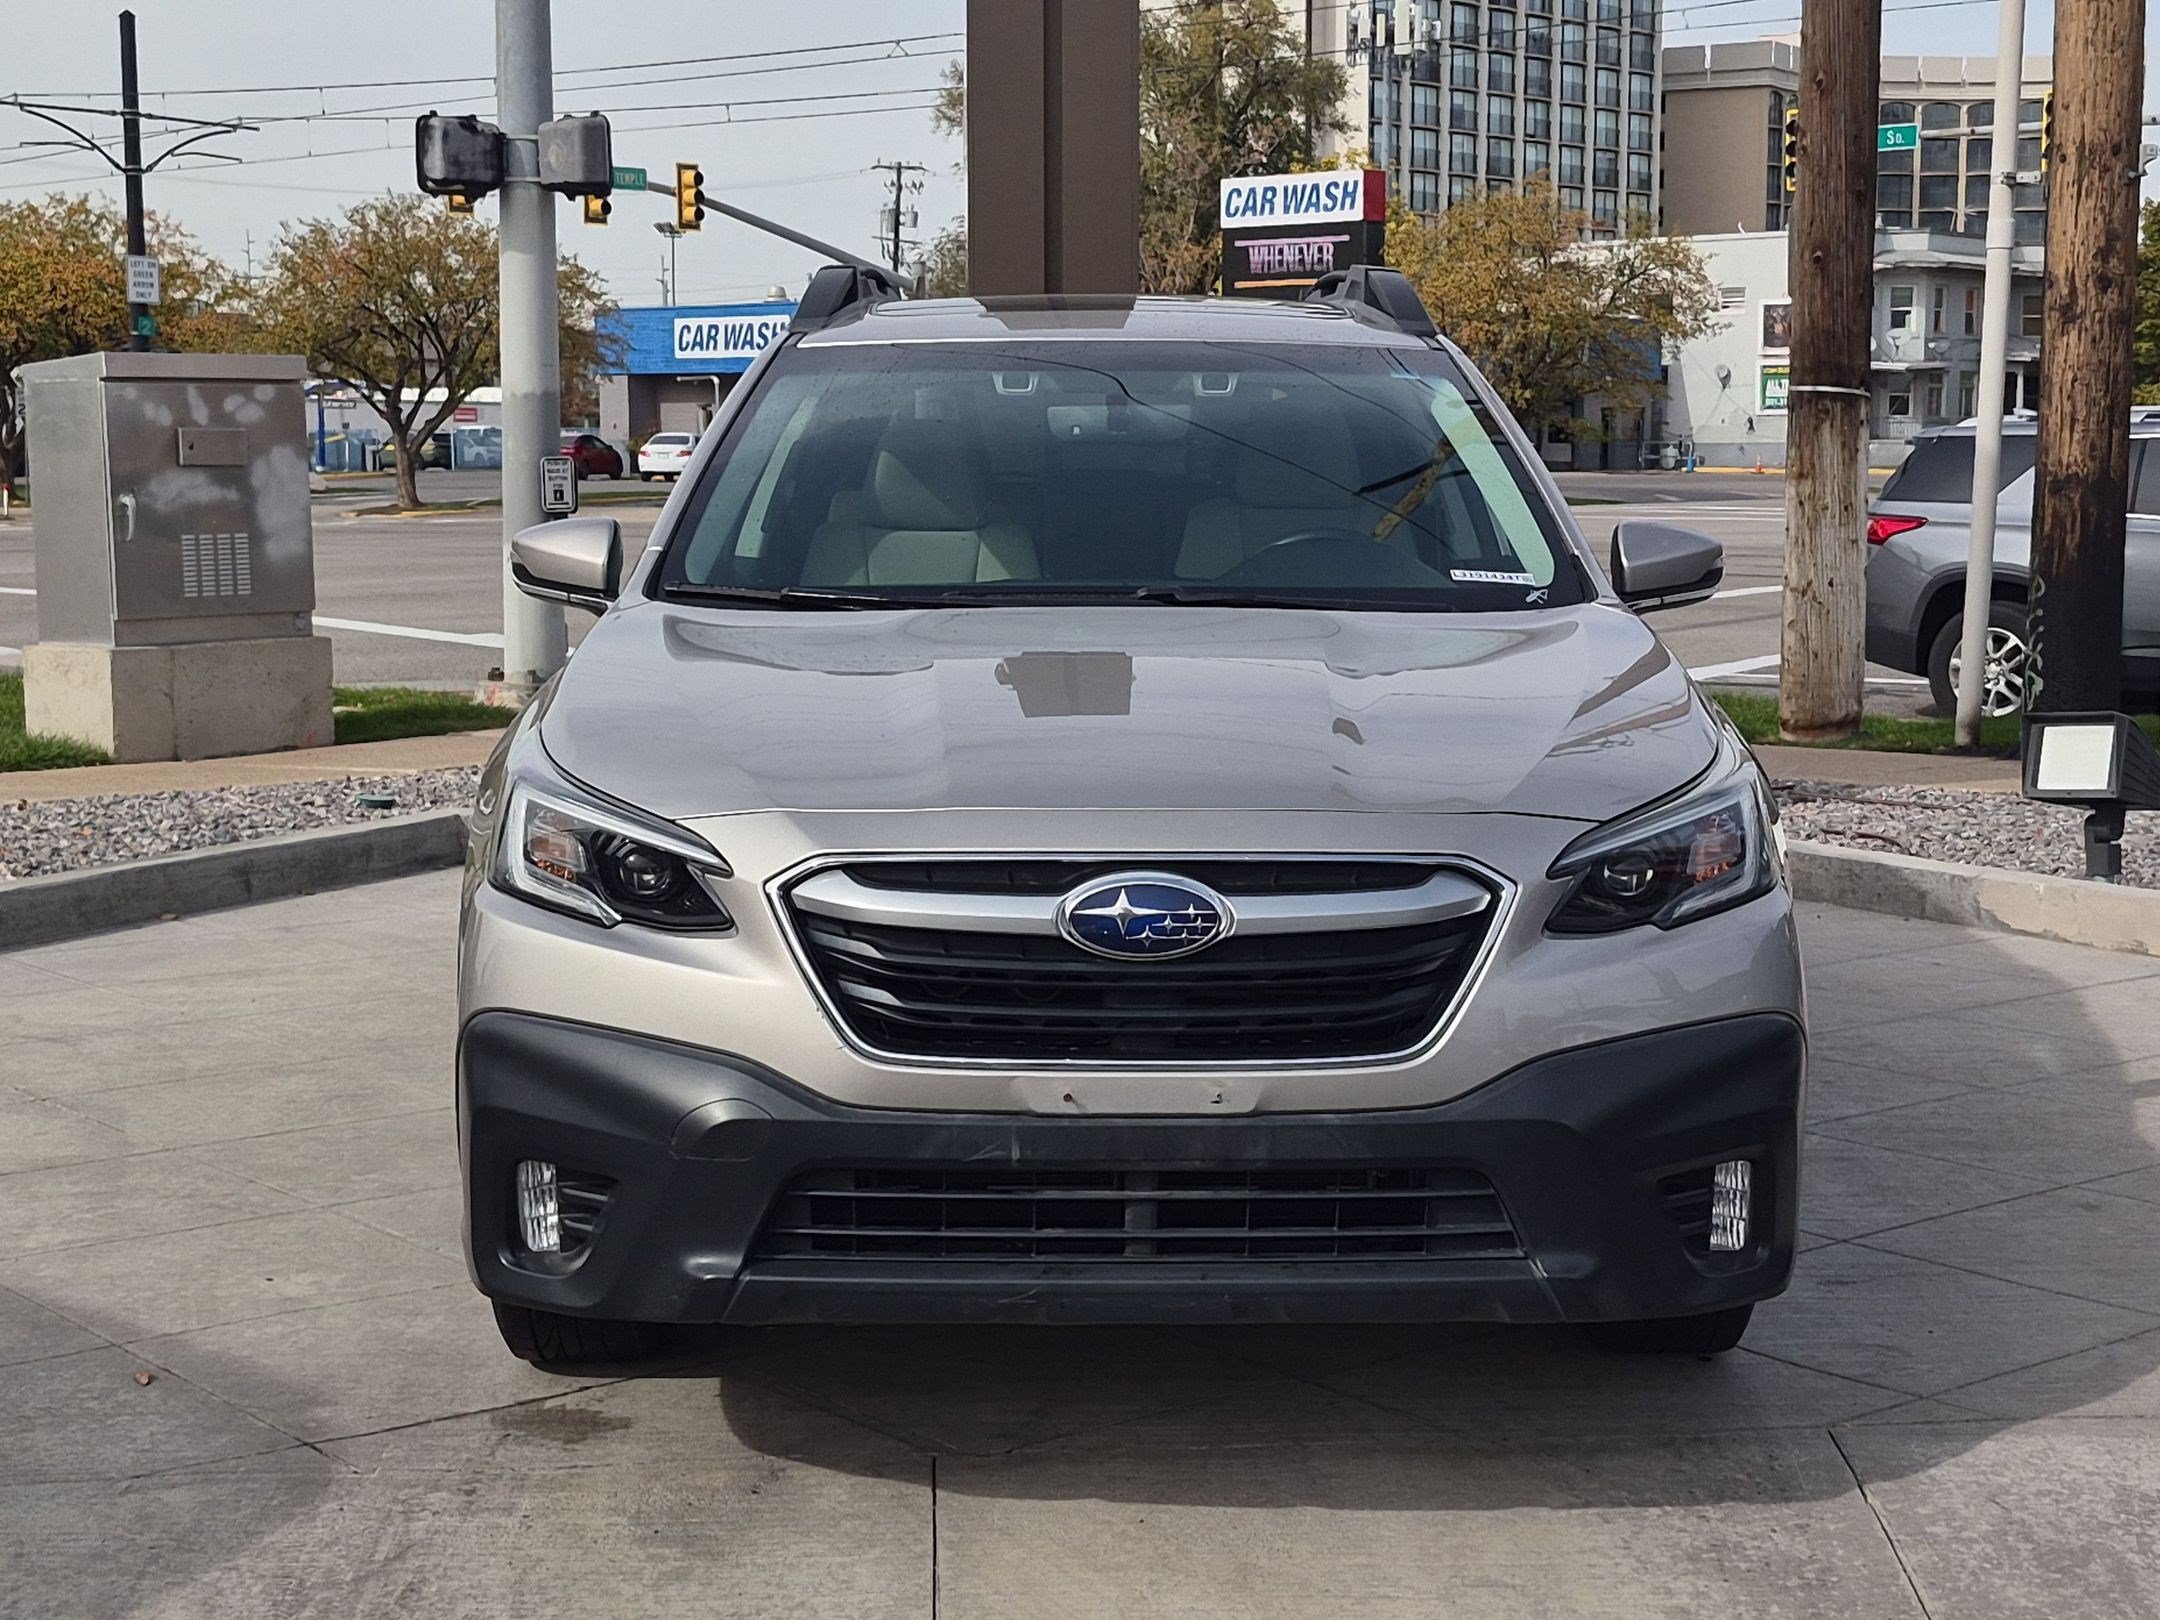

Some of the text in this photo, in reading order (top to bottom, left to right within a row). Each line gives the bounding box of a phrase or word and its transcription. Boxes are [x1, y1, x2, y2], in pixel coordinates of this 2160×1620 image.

[1225, 179, 1359, 218] CAR WASH
[1249, 242, 1335, 274] WHENEVER
[678, 324, 720, 352] CAR
